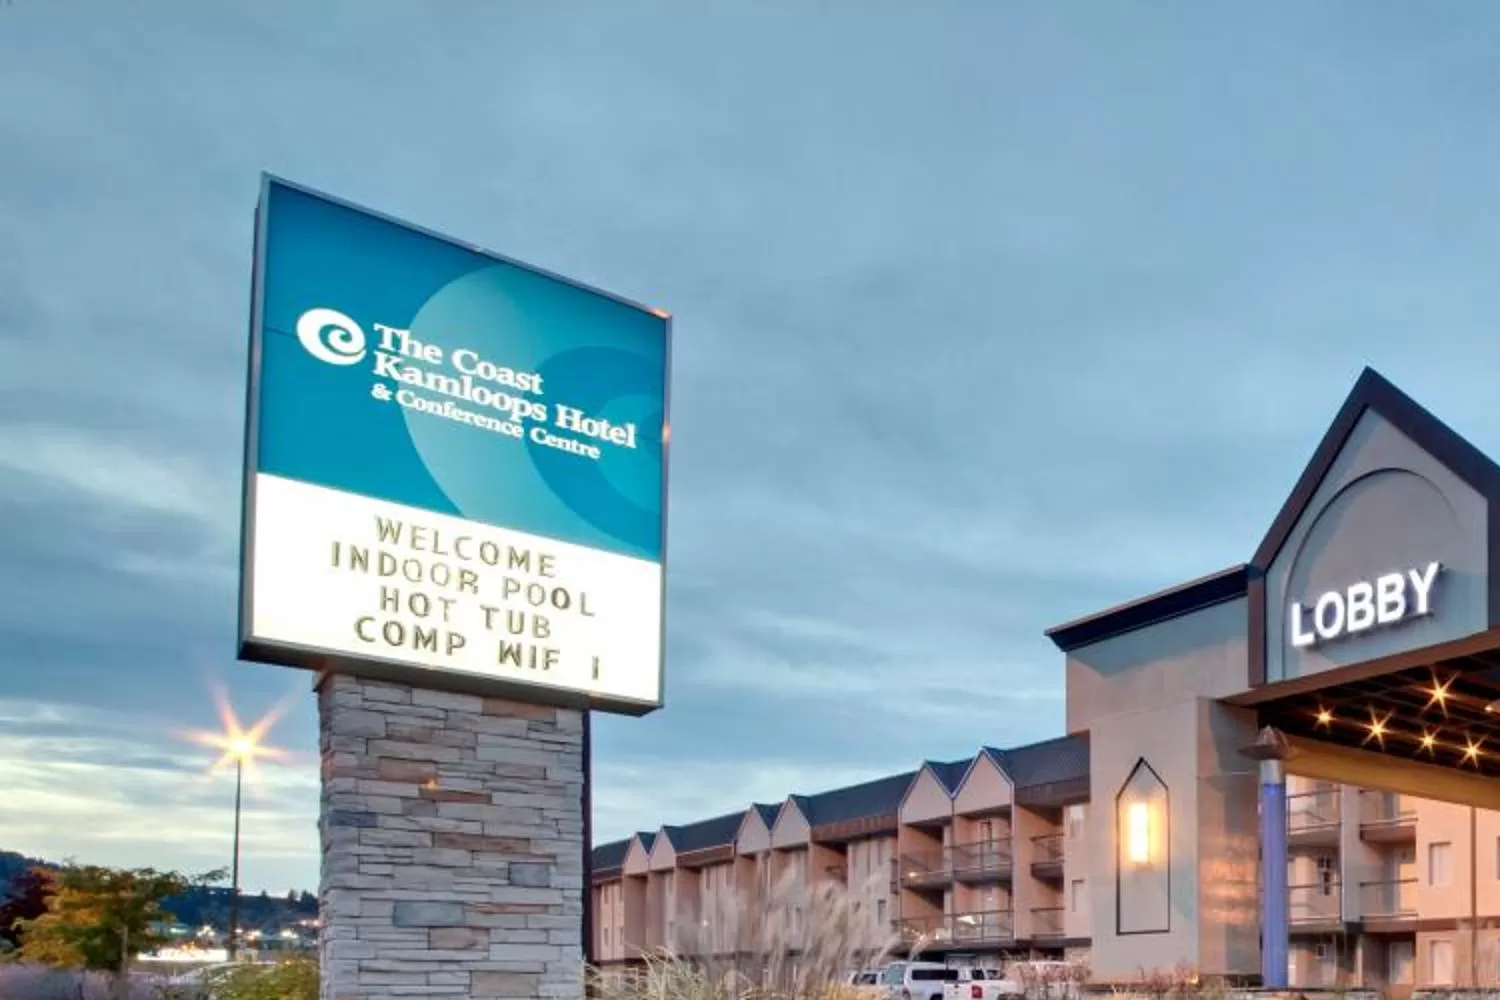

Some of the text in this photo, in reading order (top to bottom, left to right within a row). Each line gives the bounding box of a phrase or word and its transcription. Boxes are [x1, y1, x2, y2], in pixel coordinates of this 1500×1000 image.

[374, 323, 544, 395] The Coast
[371, 383, 601, 460] & Conference Centre
[373, 351, 637, 449] Kamloops Hotel
[331, 540, 596, 617] INDOOR POOL
[374, 515, 557, 579] WELCOME
[354, 616, 466, 656] COMP
[379, 585, 551, 639] HOT TUB
[1291, 561, 1439, 647] LOBBY
